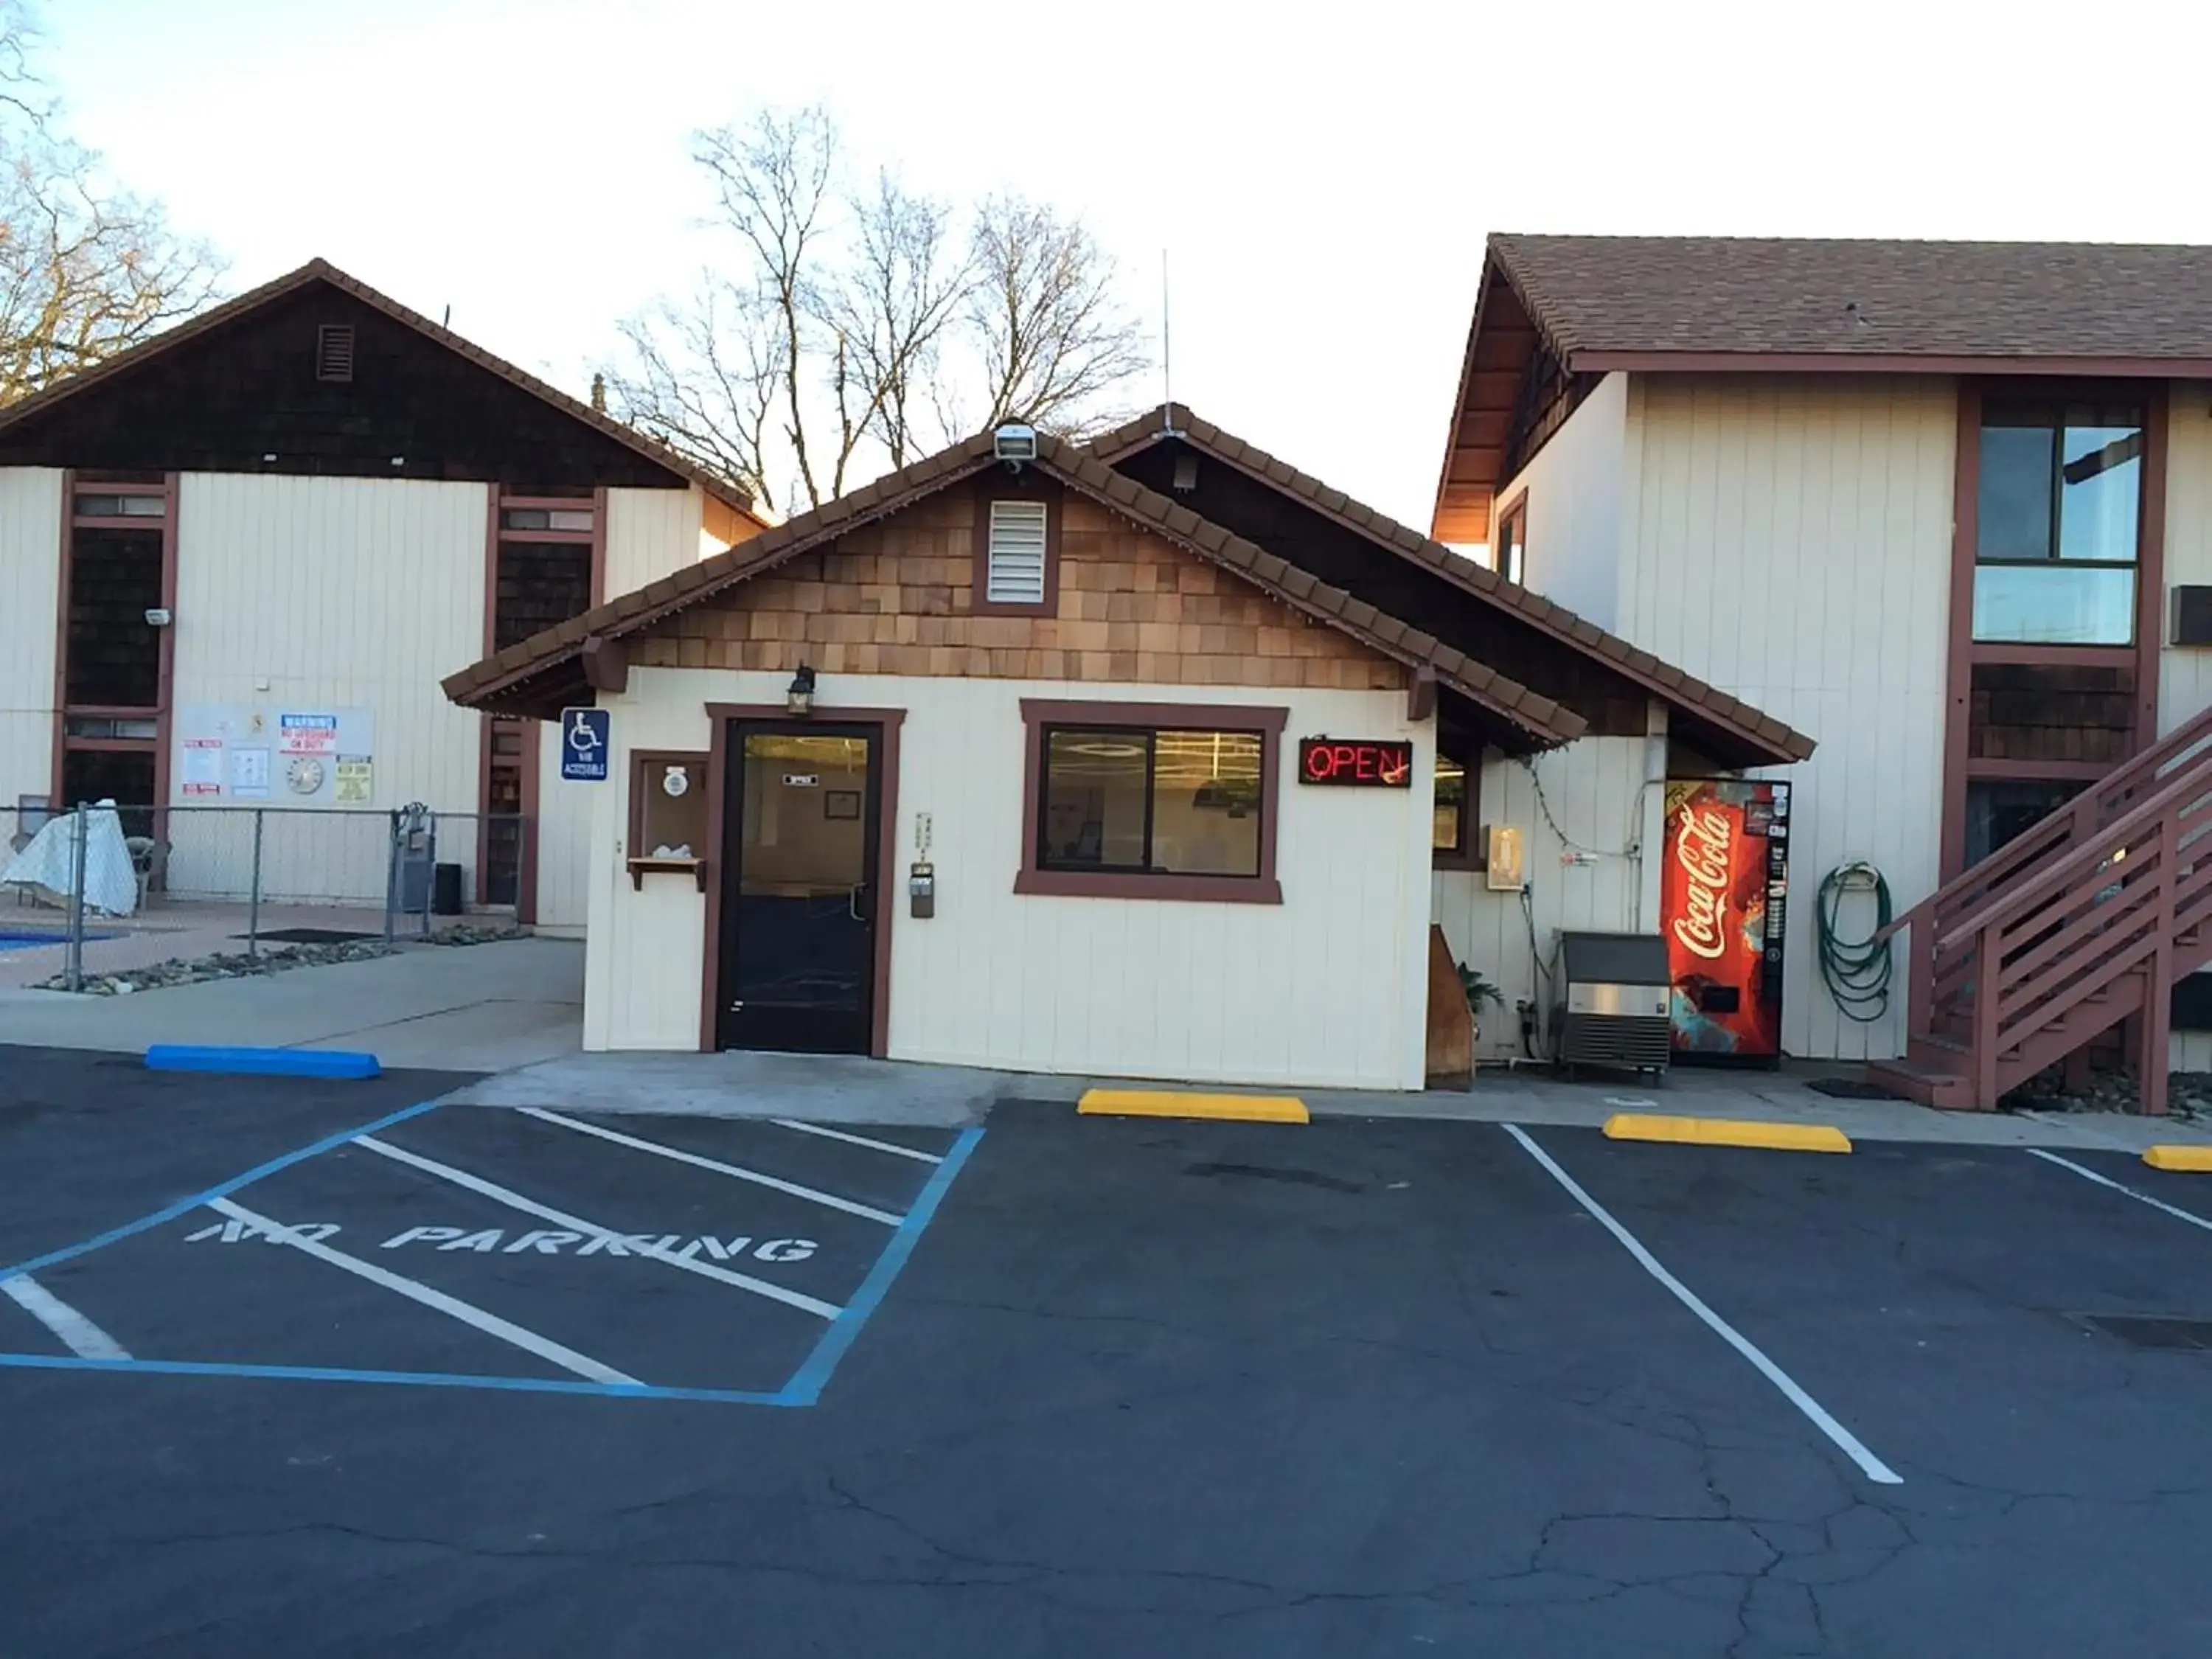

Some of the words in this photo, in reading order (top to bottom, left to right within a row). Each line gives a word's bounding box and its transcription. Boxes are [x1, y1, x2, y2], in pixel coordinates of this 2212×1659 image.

[1308, 745, 1405, 779] OPEN
[184, 1220, 342, 1244] NO
[380, 1225, 819, 1262] PARKING
